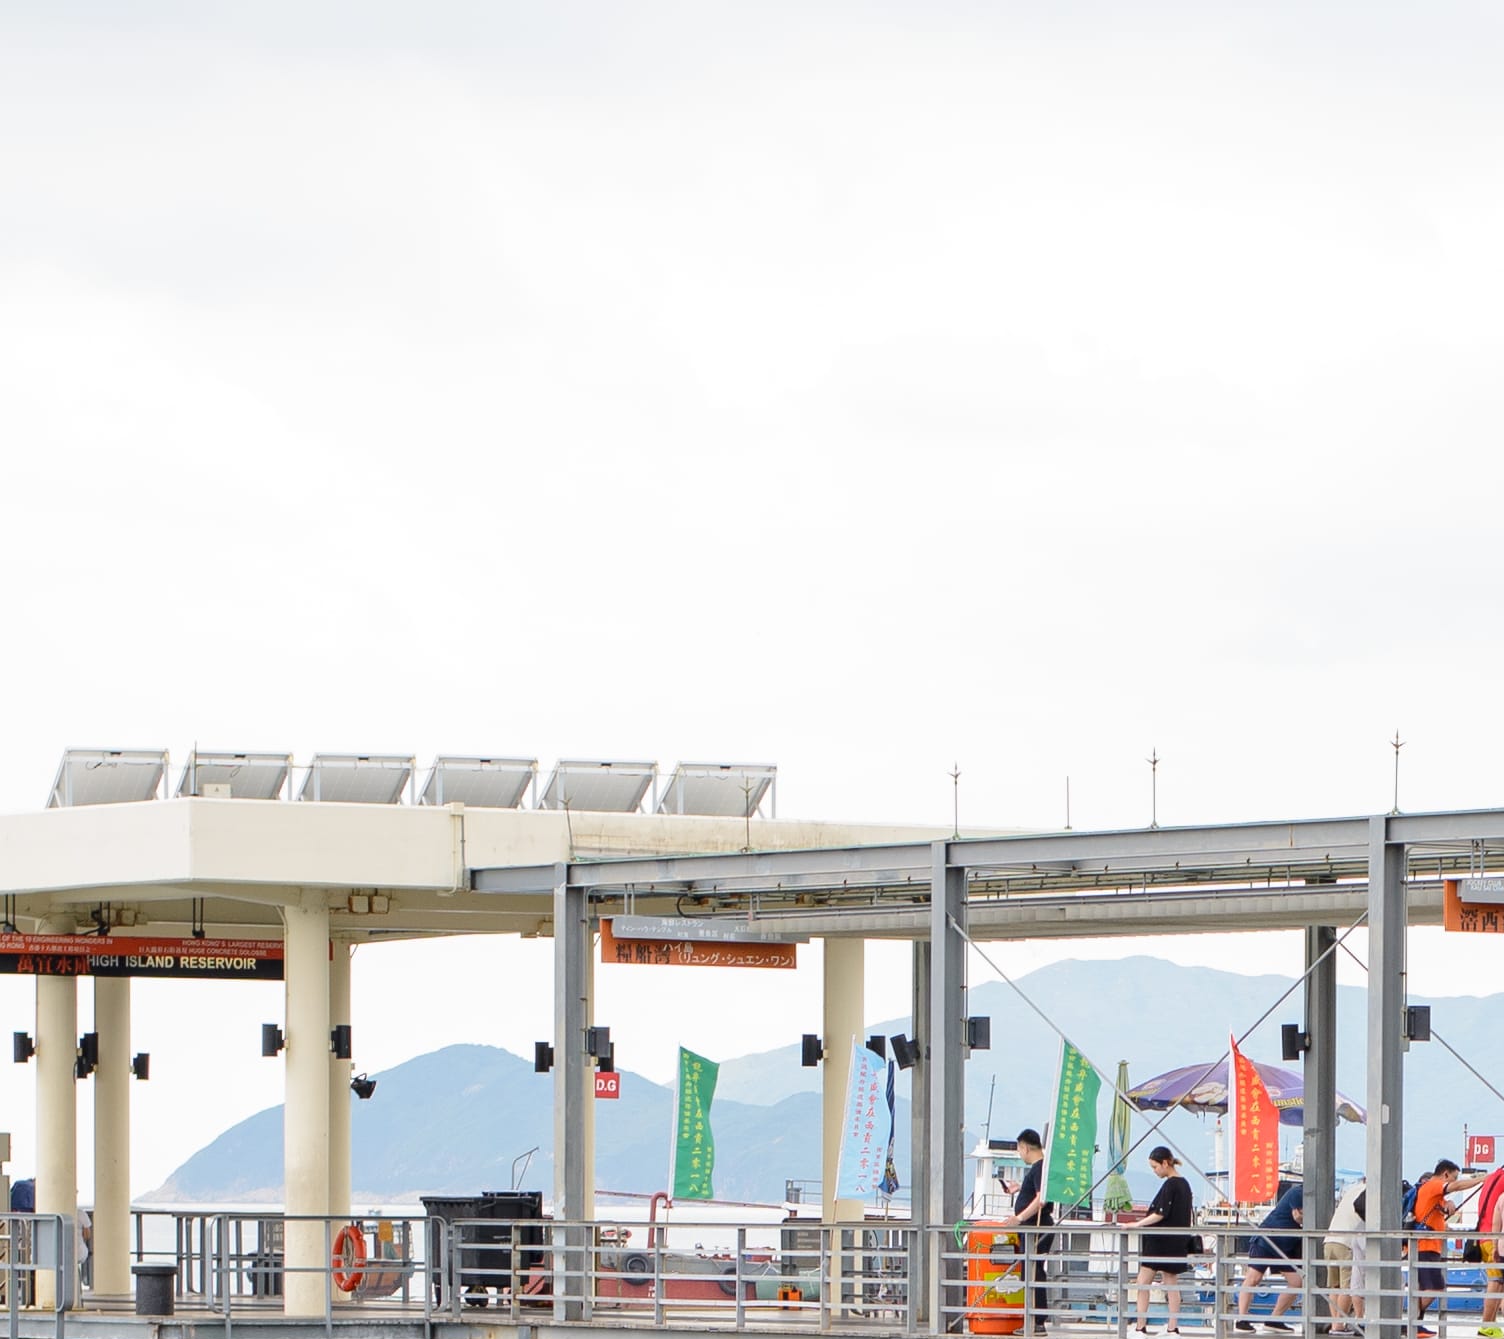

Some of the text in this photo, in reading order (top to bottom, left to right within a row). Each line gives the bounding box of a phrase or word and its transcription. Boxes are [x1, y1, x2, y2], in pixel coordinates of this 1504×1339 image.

[87, 955, 257, 970] HIGH ISLAND RESERVOIR
[596, 1079, 616, 1092] D.G
[1475, 1144, 1489, 1155] DG
